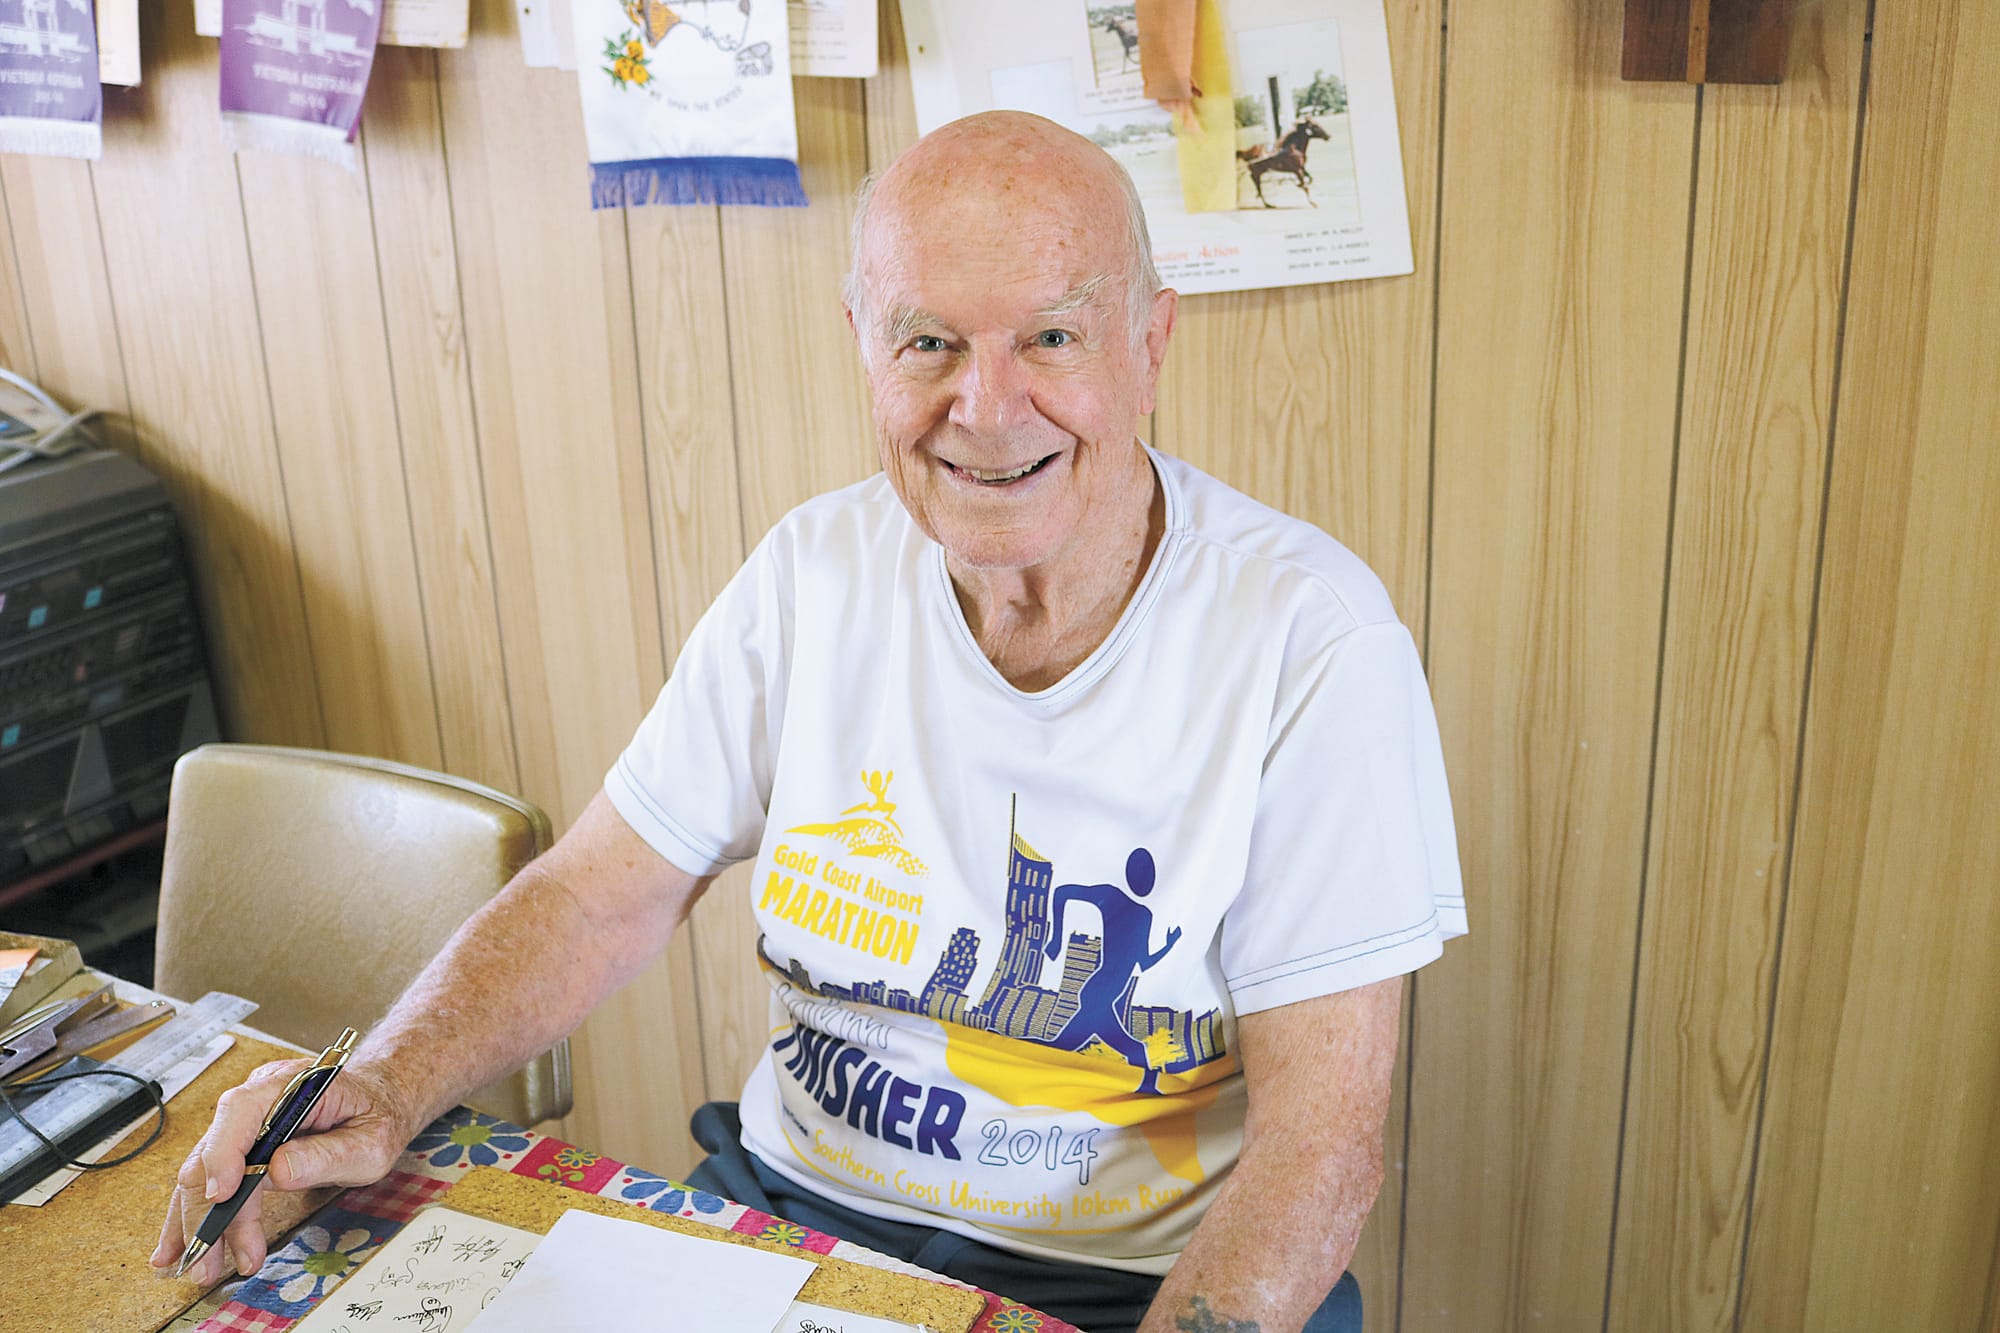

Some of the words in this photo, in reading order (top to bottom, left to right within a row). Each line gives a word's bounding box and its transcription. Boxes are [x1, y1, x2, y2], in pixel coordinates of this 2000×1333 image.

[758, 871, 919, 966] MARATHON
[773, 844, 819, 876] Gold
[822, 861, 861, 894] Coast
[864, 876, 924, 916] Airport
[812, 1129, 886, 1188] Southern
[894, 1169, 941, 1206] Cross
[950, 1180, 1062, 1227] University
[1072, 1191, 1131, 1218] 10km
[1137, 1184, 1185, 1212] Run
[977, 1118, 1100, 1186] 2014
